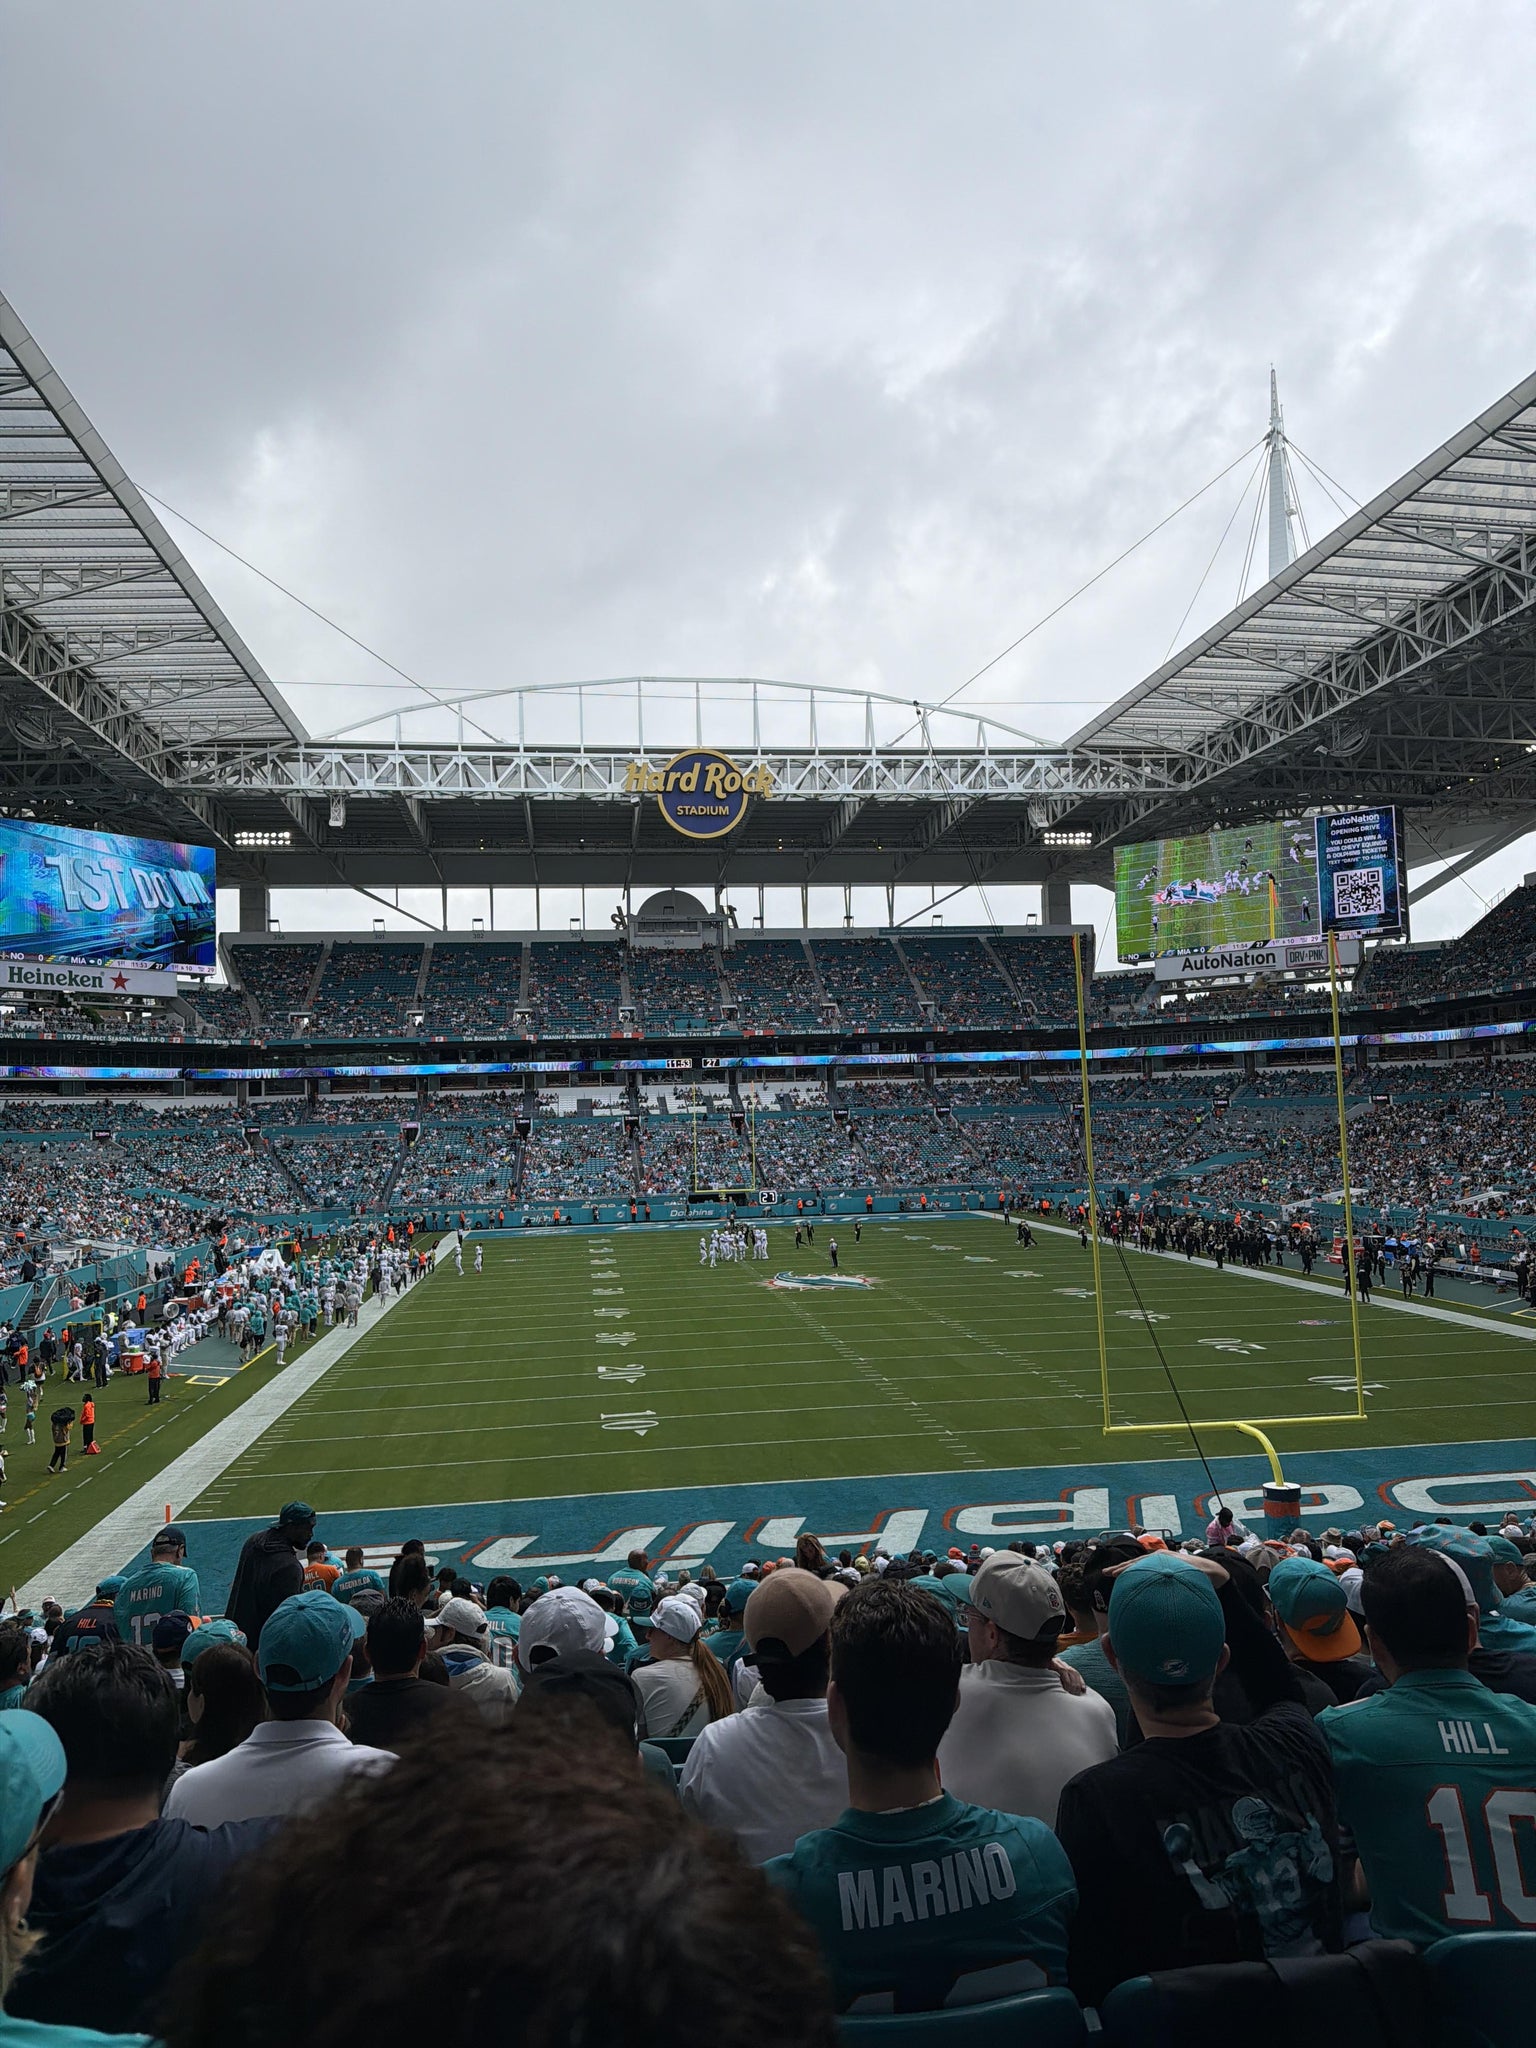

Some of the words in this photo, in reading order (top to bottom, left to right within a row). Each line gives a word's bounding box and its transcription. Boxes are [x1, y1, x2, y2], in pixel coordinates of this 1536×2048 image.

[625, 762, 701, 792] Hard
[704, 762, 775, 799] Rock
[677, 805, 730, 816] STADIUM
[1330, 813, 1380, 827] AutoNation
[1331, 827, 1360, 836] OPENING
[1360, 824, 1380, 832] DRIVE
[1343, 836, 1363, 844] COULD
[44, 853, 129, 913] 1ST
[10, 952, 25, 960] NO
[38, 954, 44, 962] 0
[70, 956, 87, 965] MIA
[96, 958, 103, 966] 0
[1177, 948, 1192, 956] MIA
[1289, 951, 1305, 963] DRV
[1308, 948, 1325, 961] PNK
[1182, 952, 1276, 972] AutoNation
[8, 966, 104, 988] Heineken
[666, 1059, 691, 1068] 11:53
[705, 1058, 717, 1067] 27
[761, 1192, 775, 1203] 27
[124, 1359, 131, 1368] G
[597, 1364, 647, 1380] 20
[600, 1410, 660, 1430] 10
[130, 1585, 163, 1602] MARINO
[77, 1617, 97, 1629] HILL
[1437, 1720, 1509, 1755] HILL
[1426, 1784, 1536, 1926] 10
[837, 1841, 1017, 1932] MARINO
